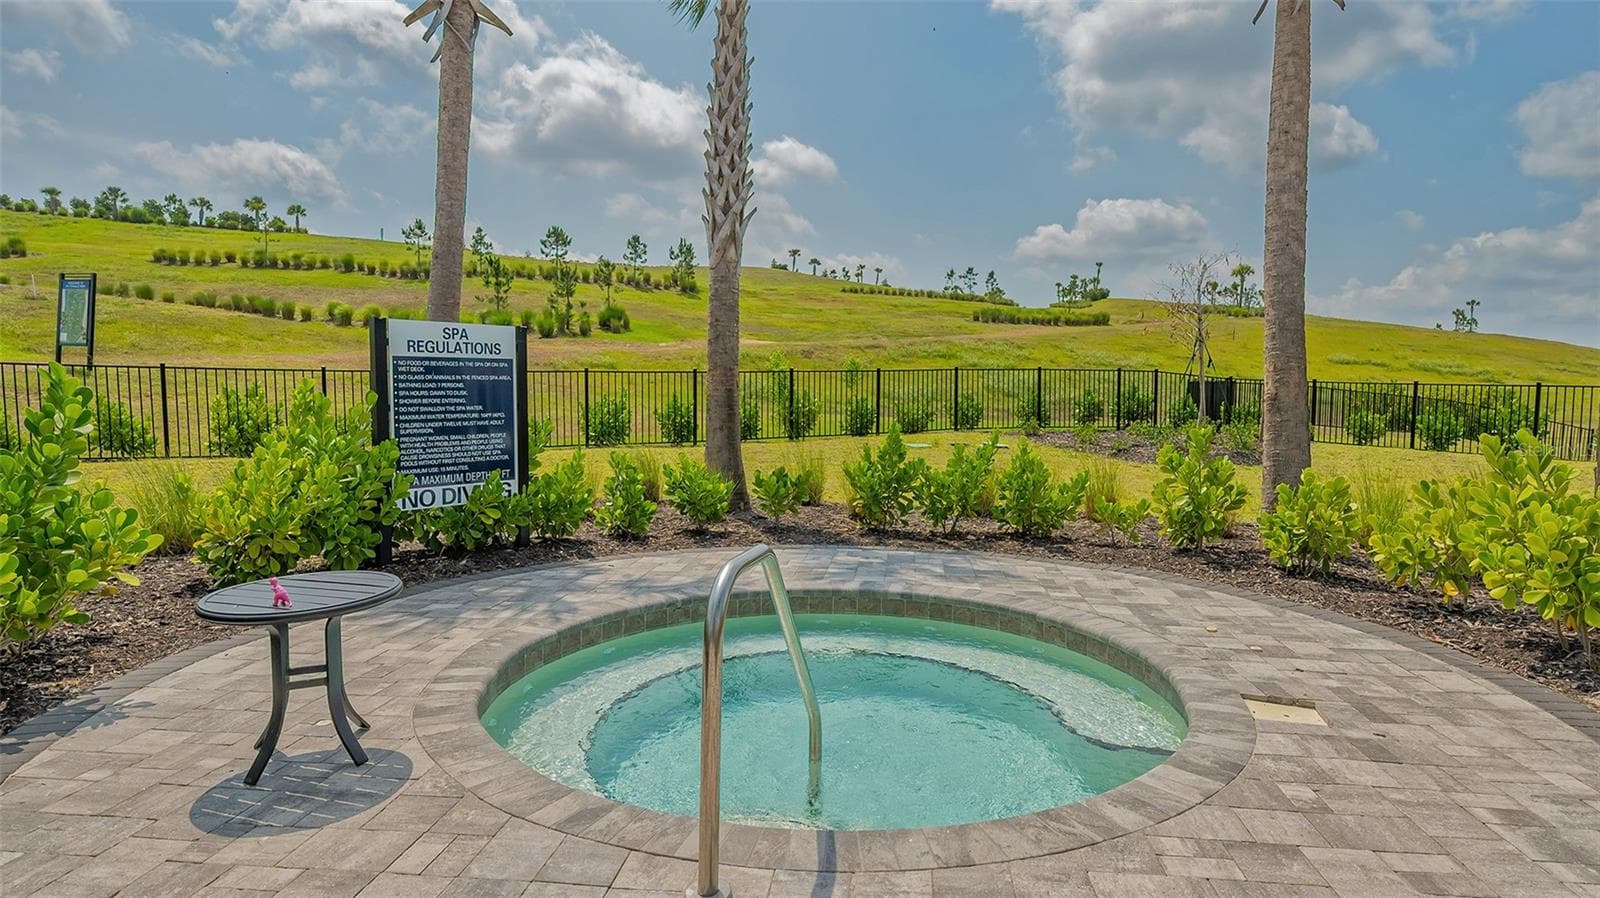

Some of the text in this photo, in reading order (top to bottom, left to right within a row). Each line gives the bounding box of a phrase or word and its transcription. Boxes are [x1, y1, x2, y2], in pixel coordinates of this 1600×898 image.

[442, 327, 469, 340] SPA
[407, 340, 502, 355] REGULATIONS
[422, 474, 464, 485] MAXIMUM
[466, 471, 491, 482] DEPTH
[502, 469, 511, 478] FT
[401, 482, 512, 509] NO DIVG
